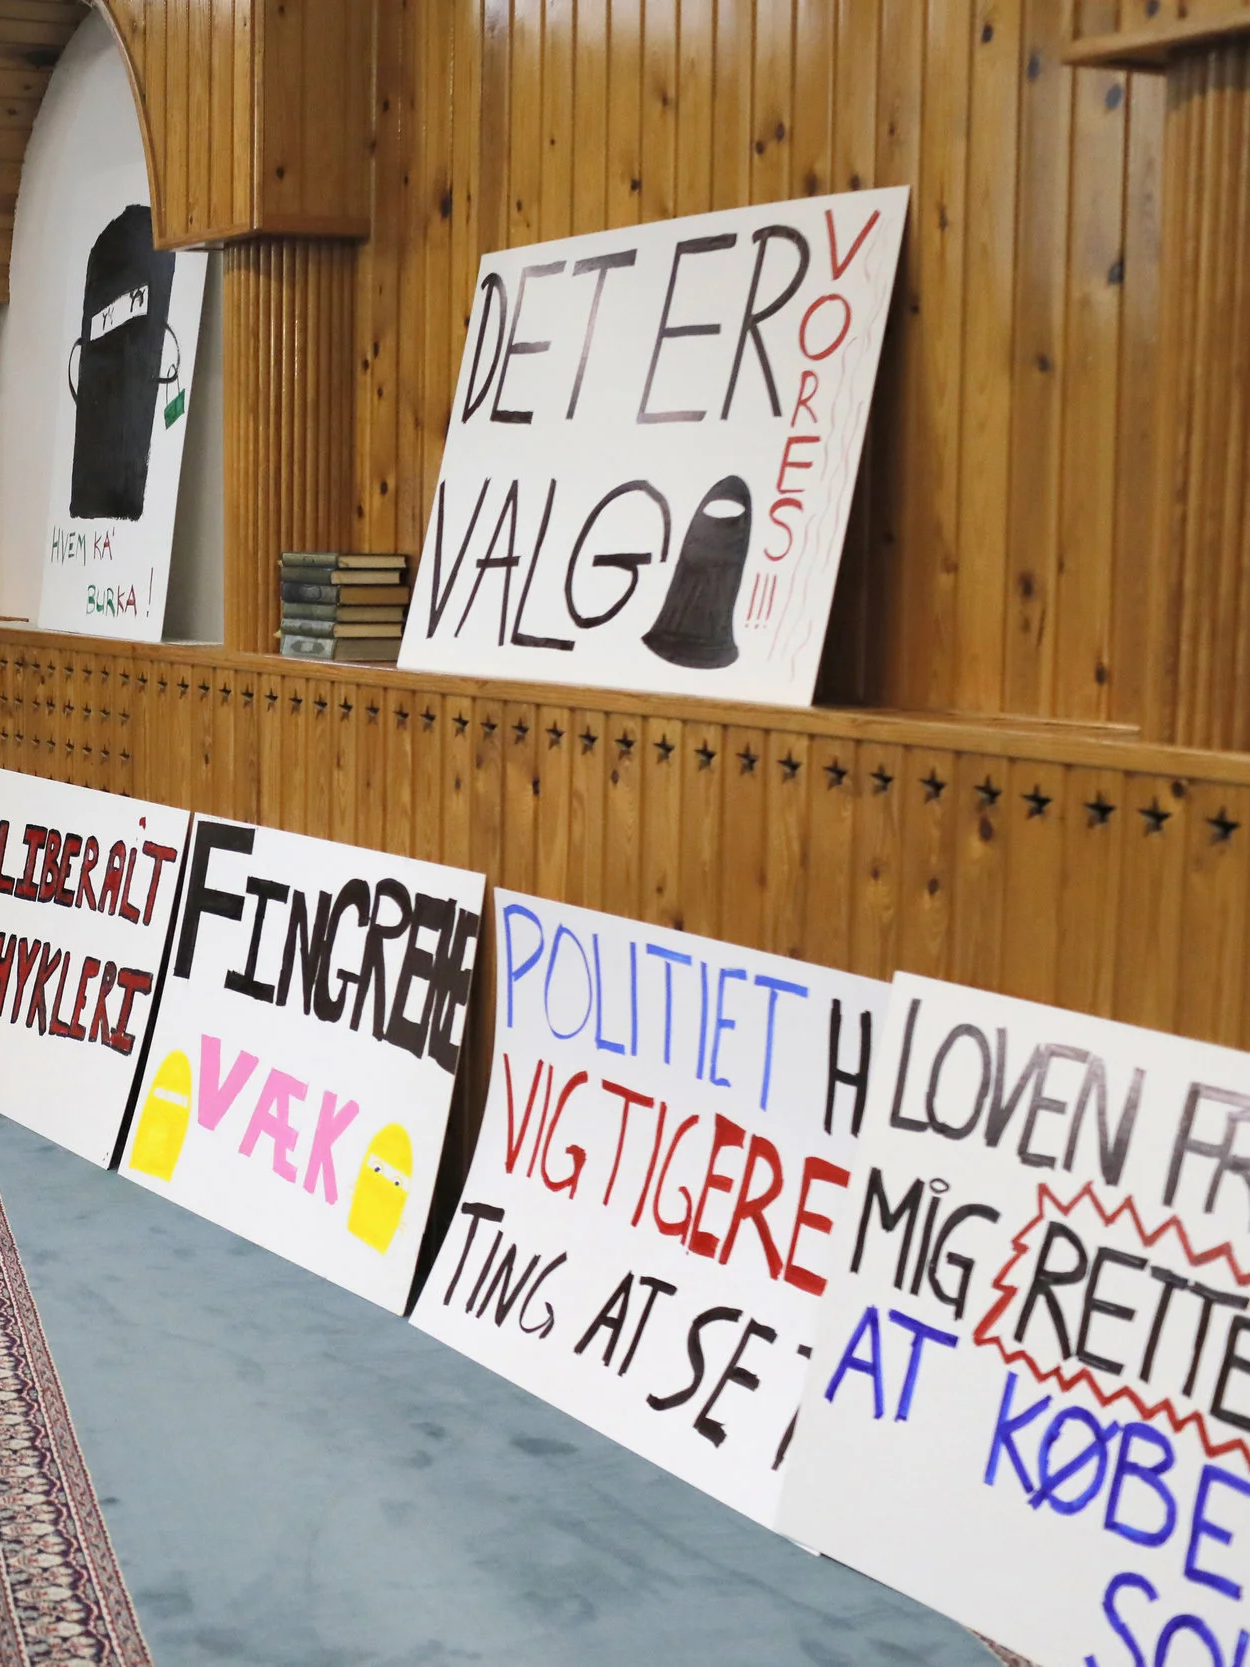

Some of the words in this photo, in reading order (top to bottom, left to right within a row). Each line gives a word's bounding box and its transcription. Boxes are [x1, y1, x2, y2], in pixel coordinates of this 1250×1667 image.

[461, 248, 638, 425] DET
[636, 224, 811, 425] ER
[763, 208, 881, 562] VORES
[50, 525, 86, 567] HVEM
[86, 584, 137, 618] BURKA
[426, 477, 672, 652] VALG
[173, 820, 481, 1076] FINGRENE
[502, 904, 809, 1112] POLITIET
[198, 1034, 360, 1206] VÆK
[502, 1052, 851, 1298] VIGTIGERE
[888, 997, 1147, 1187] LOVEN
[443, 1201, 568, 1340] TING
[574, 1270, 678, 1378] AT
[646, 1305, 778, 1449] SE
[824, 1304, 958, 1423] AT
[982, 1370, 1250, 1602] KØBE
